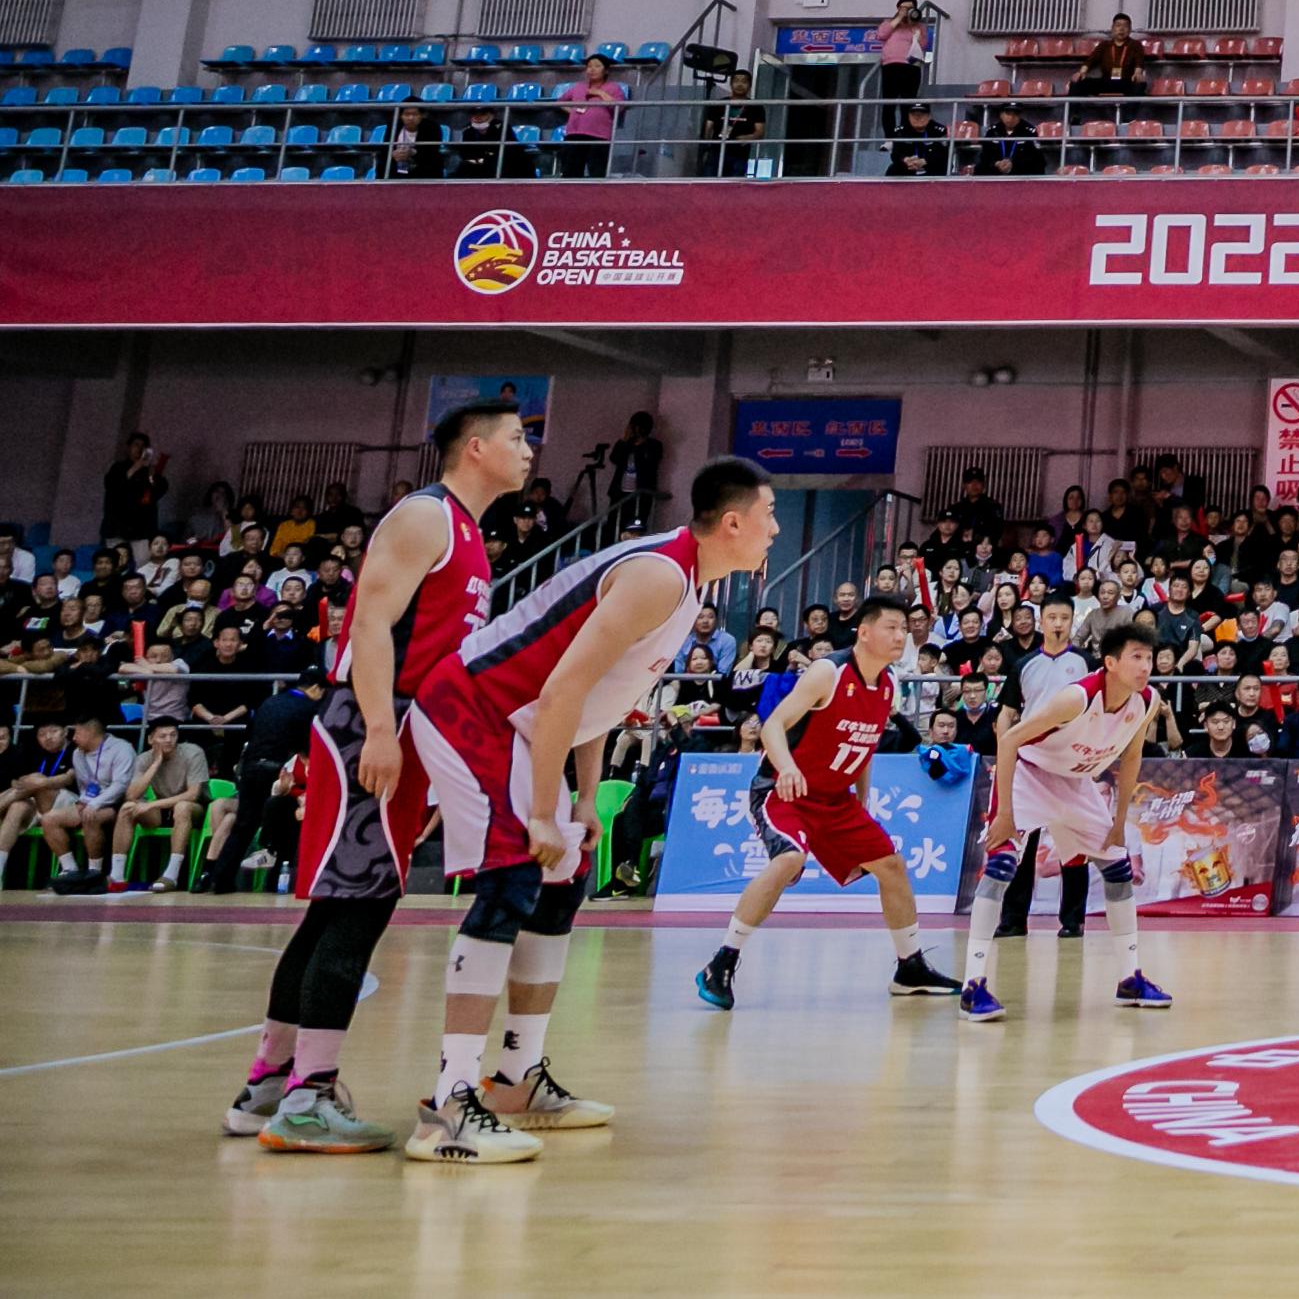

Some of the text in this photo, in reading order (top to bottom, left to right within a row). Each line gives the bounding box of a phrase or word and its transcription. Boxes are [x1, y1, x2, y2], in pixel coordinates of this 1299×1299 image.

[547, 232, 612, 248] CHINA
[542, 250, 684, 267] BASKETBALL
[536, 268, 594, 285] OPEN
[829, 742, 870, 775] 17
